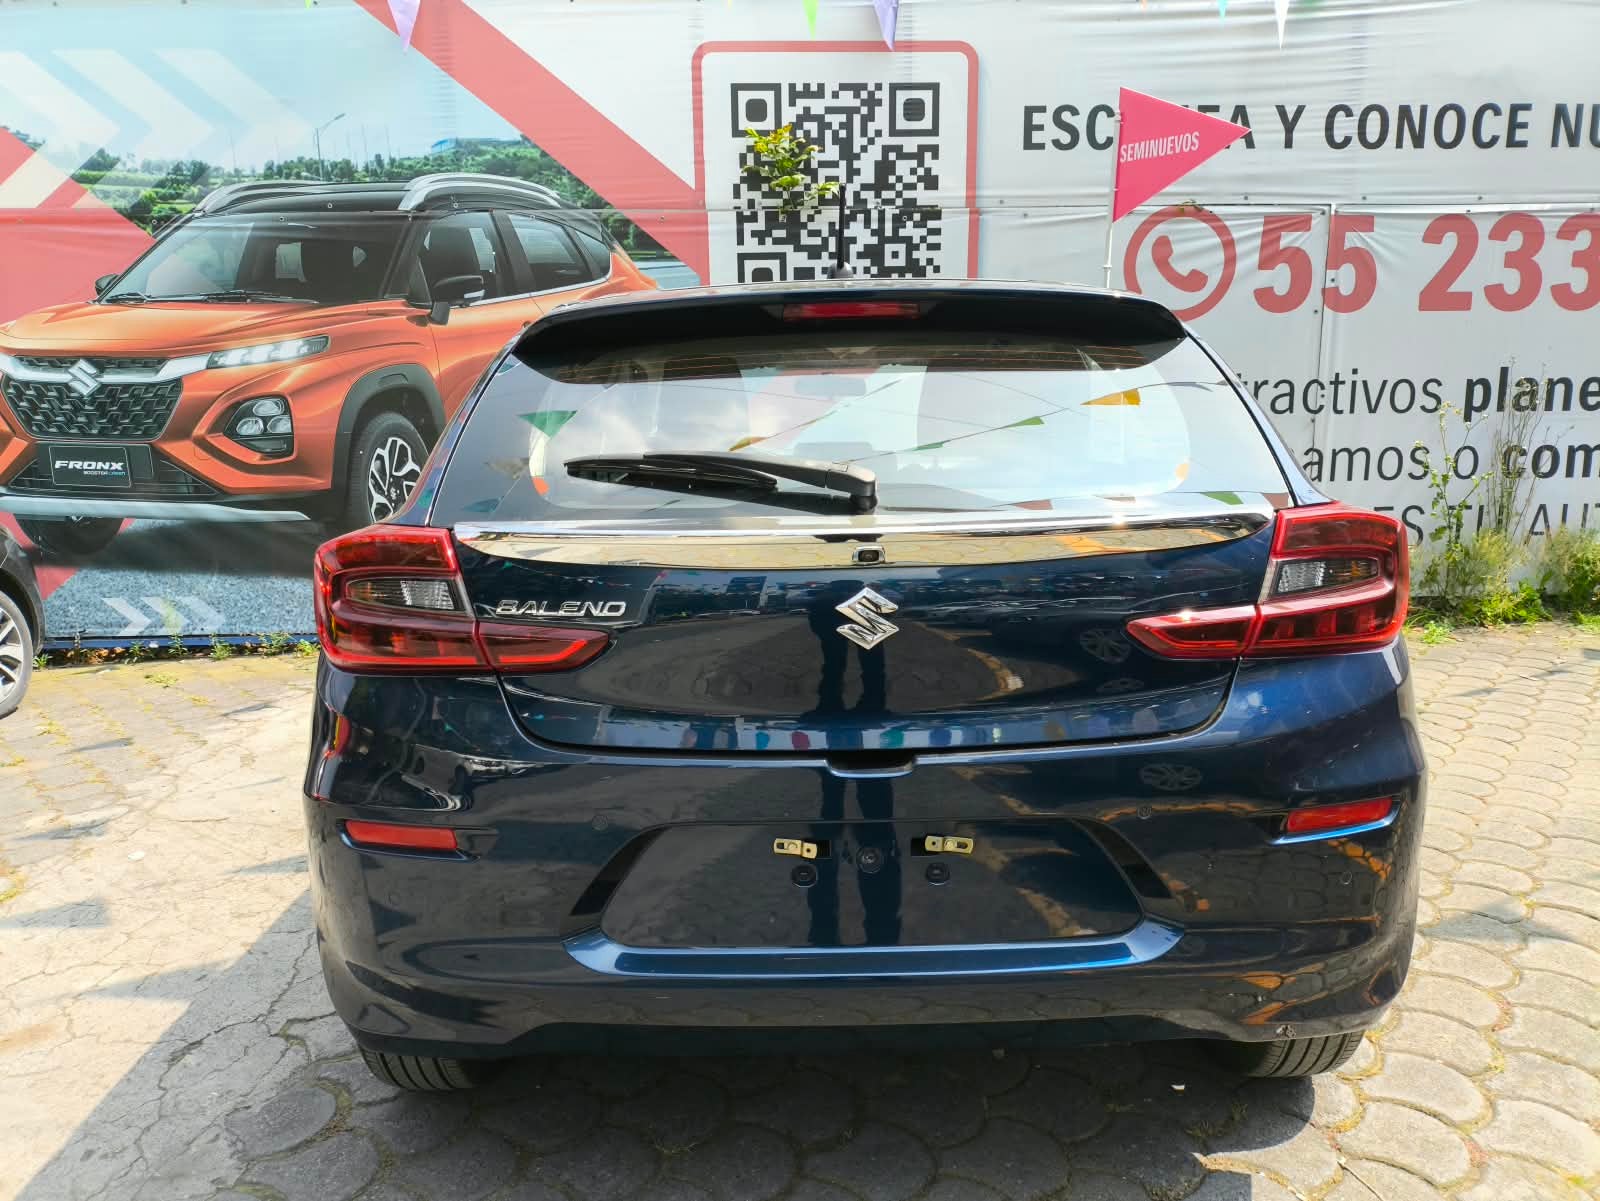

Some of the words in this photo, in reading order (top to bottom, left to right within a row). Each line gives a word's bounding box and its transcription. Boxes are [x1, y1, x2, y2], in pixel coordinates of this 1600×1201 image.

[1023, 104, 1256, 151] ESCA
[1275, 104, 1308, 149] Y
[1324, 103, 1532, 150] CONOCE
[1119, 131, 1200, 163] SEMINUEVOS
[1253, 214, 1378, 314] 55
[1418, 213, 1600, 313] 233
[1236, 367, 1443, 415] ractivos
[1463, 366, 1600, 423] plane
[55, 460, 124, 470] FRONX
[1292, 446, 1430, 482] amos
[1453, 445, 1479, 480] o
[1503, 443, 1600, 479] com
[495, 599, 627, 617] BALENO
